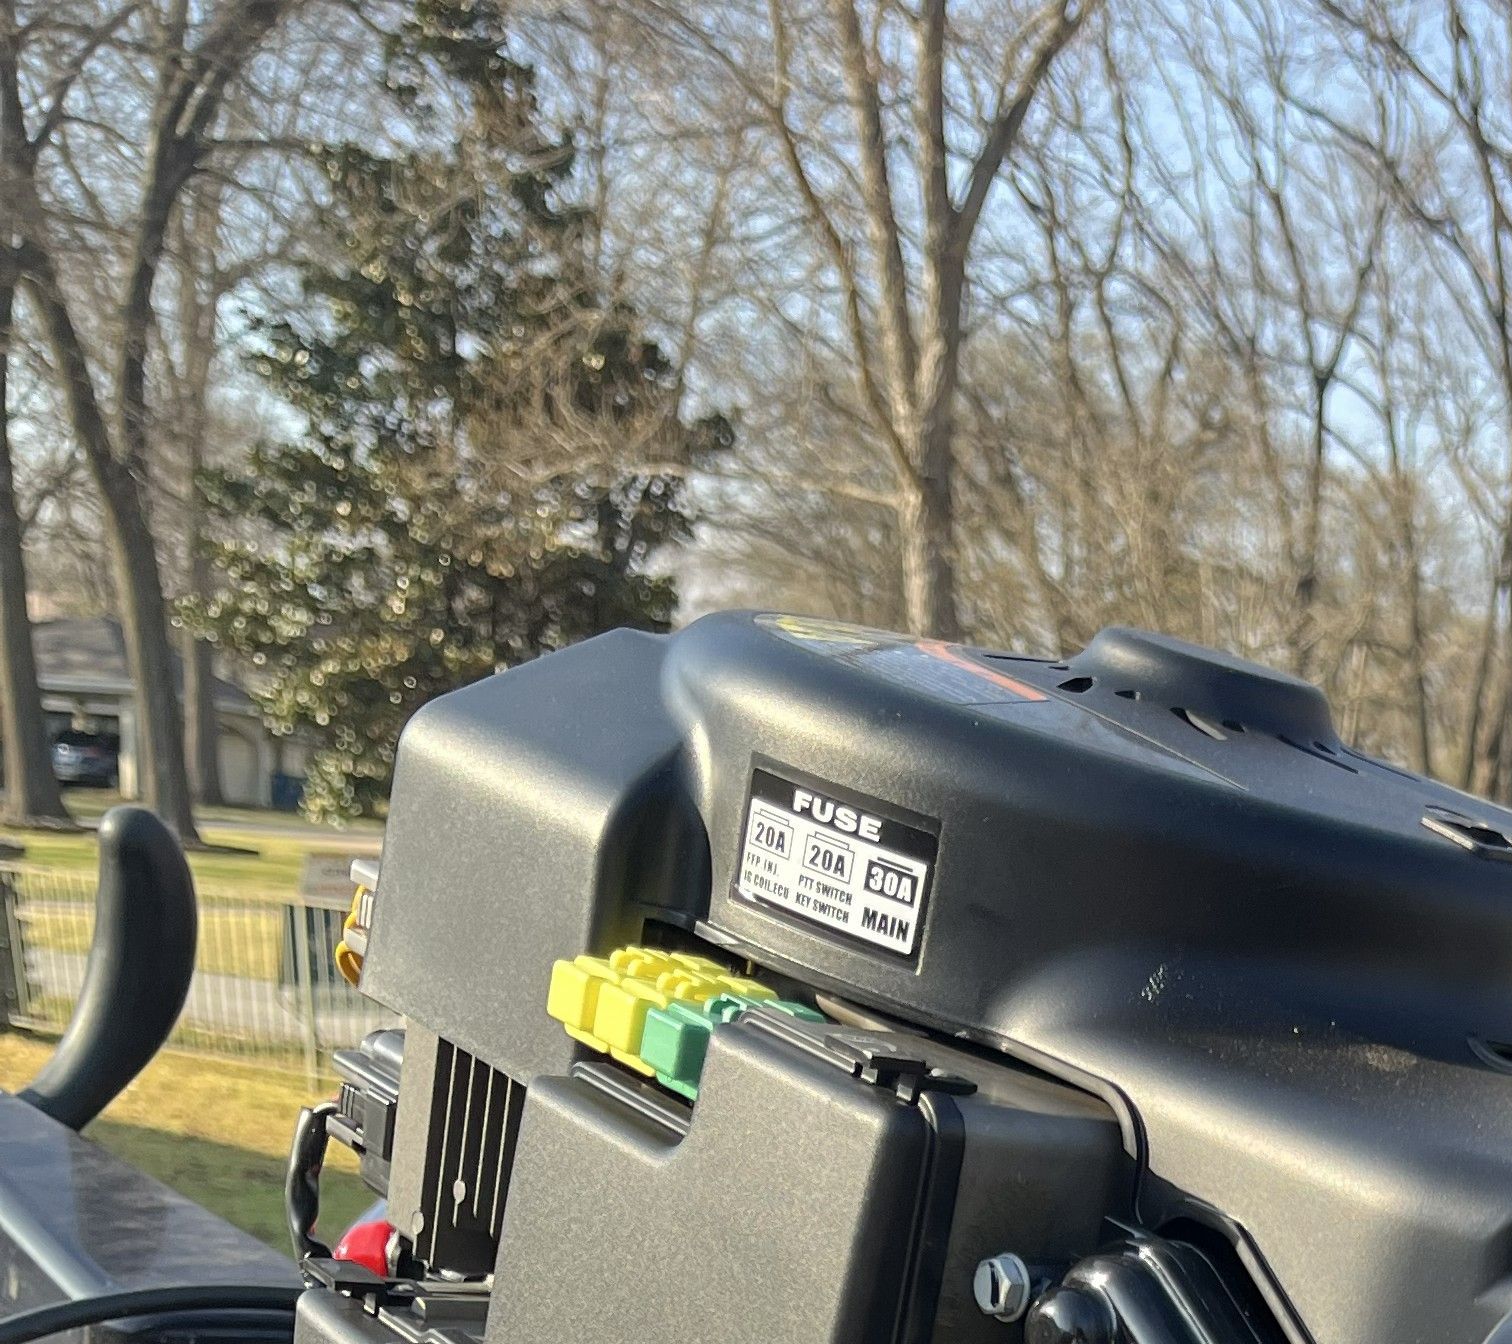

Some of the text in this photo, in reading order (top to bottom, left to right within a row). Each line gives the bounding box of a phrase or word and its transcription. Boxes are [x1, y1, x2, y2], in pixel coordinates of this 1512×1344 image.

[793, 789, 882, 842] FUSE
[755, 821, 786, 853] 20A
[809, 844, 845, 877] 20A
[798, 874, 853, 906] PTT SWITCH
[869, 866, 912, 902] 30A
[795, 892, 849, 924] KEY SWITCH
[861, 907, 910, 942] MAIN
